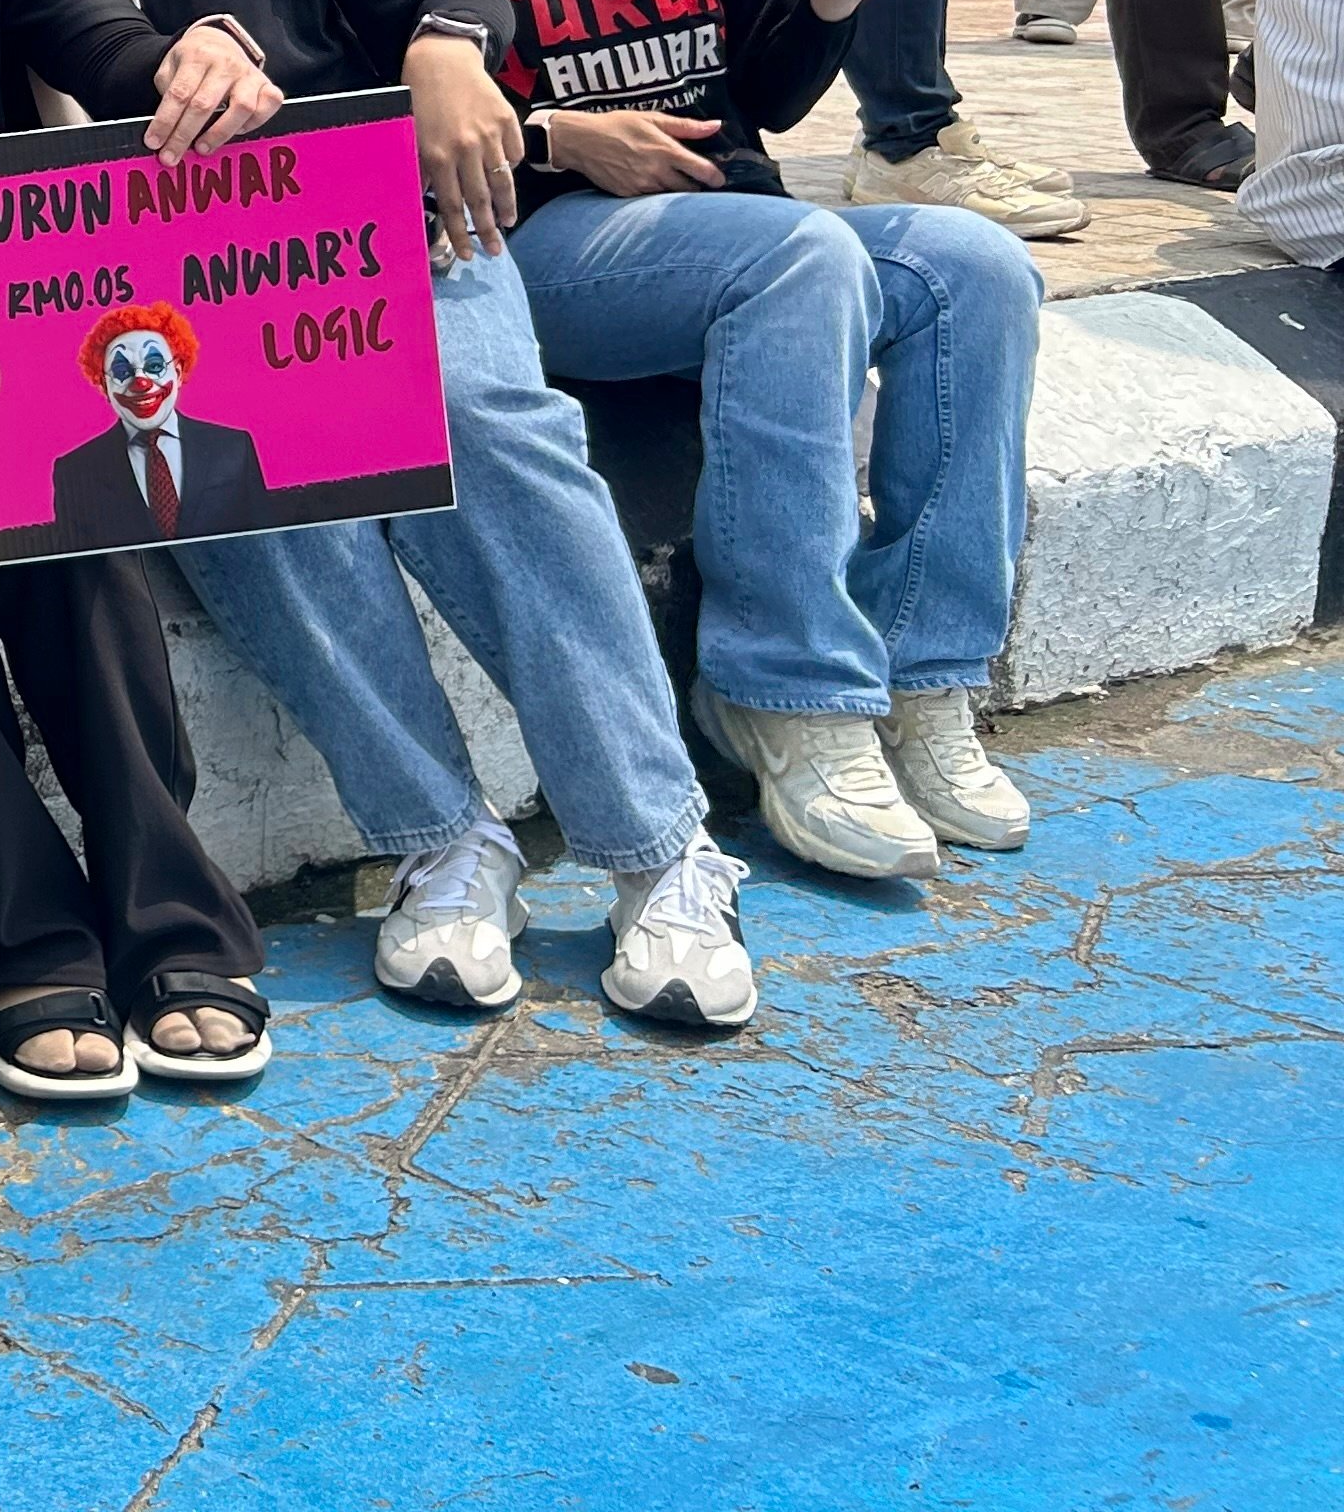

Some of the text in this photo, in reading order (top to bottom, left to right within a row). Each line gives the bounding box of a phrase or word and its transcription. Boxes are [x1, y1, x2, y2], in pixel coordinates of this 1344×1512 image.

[542, 23, 720, 100] ANWAR
[126, 146, 302, 225] ANWAR
[8, 264, 135, 320] RM0.05
[182, 221, 383, 307] ANWAR'S
[261, 298, 394, 371] LOGIC
